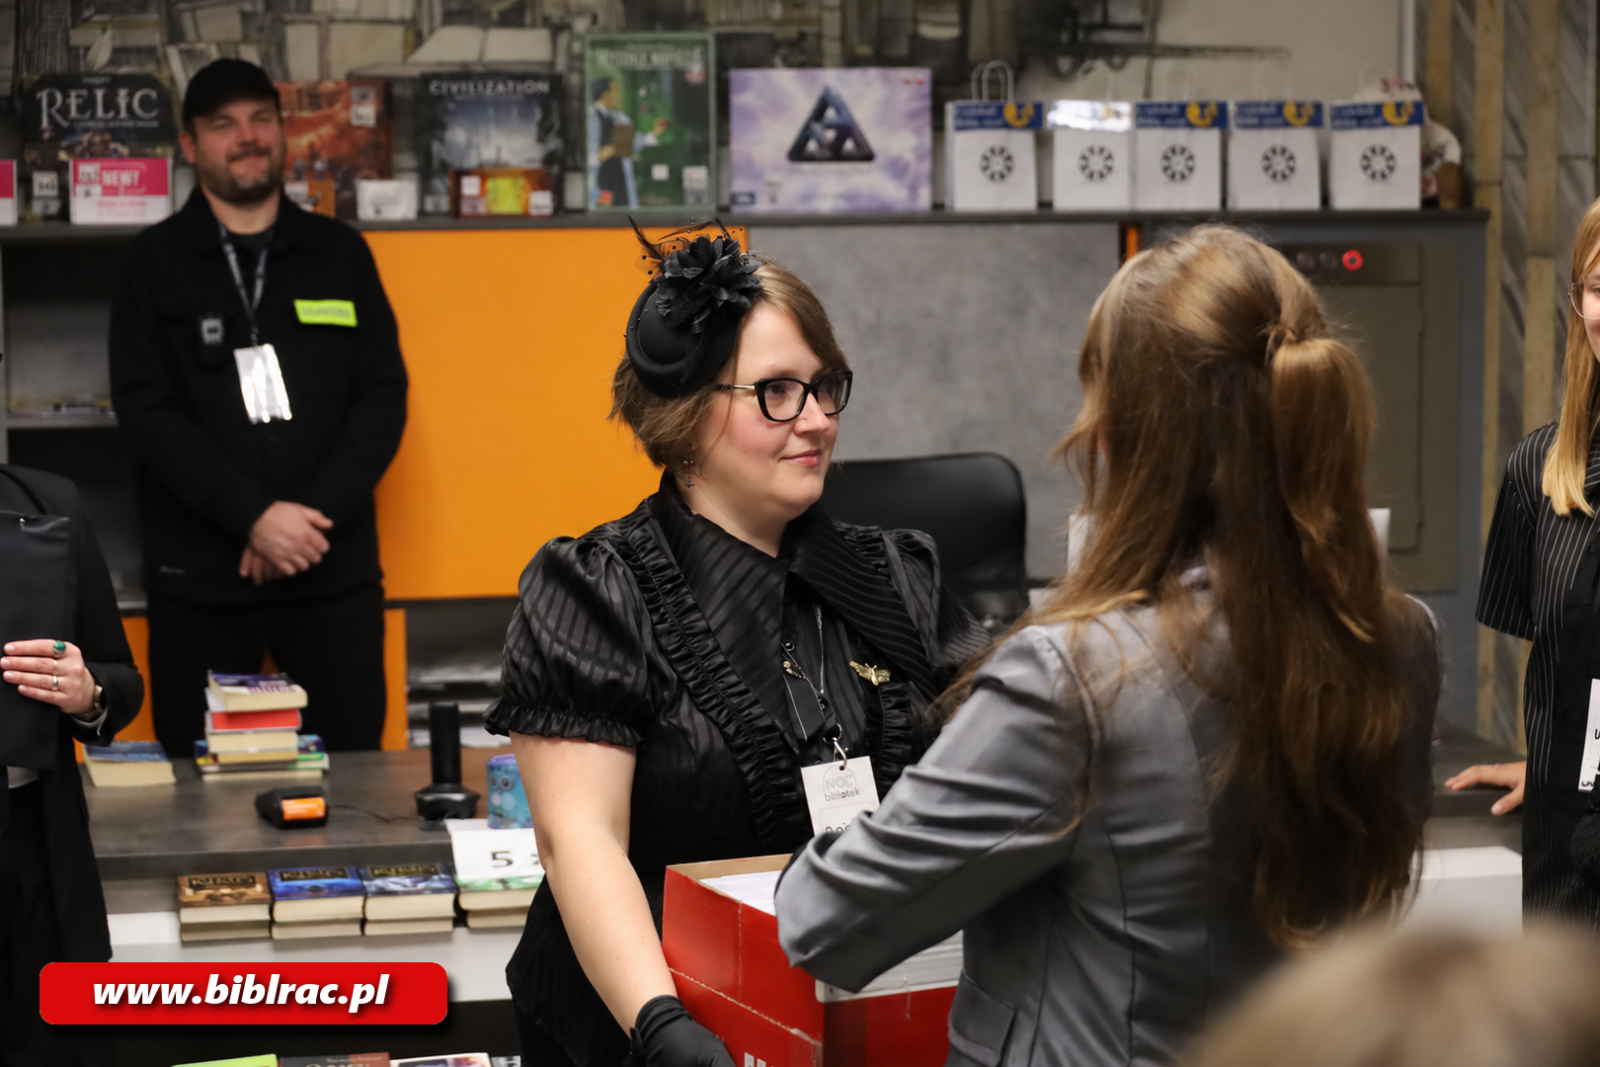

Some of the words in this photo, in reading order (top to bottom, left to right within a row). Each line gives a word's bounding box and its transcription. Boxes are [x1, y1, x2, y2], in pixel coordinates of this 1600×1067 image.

[428, 79, 550, 96] CIVILIZATION
[36, 87, 159, 129] RELIC
[825, 774, 854, 791] NOC
[824, 787, 861, 802] bibliotek
[491, 851, 514, 868] 5
